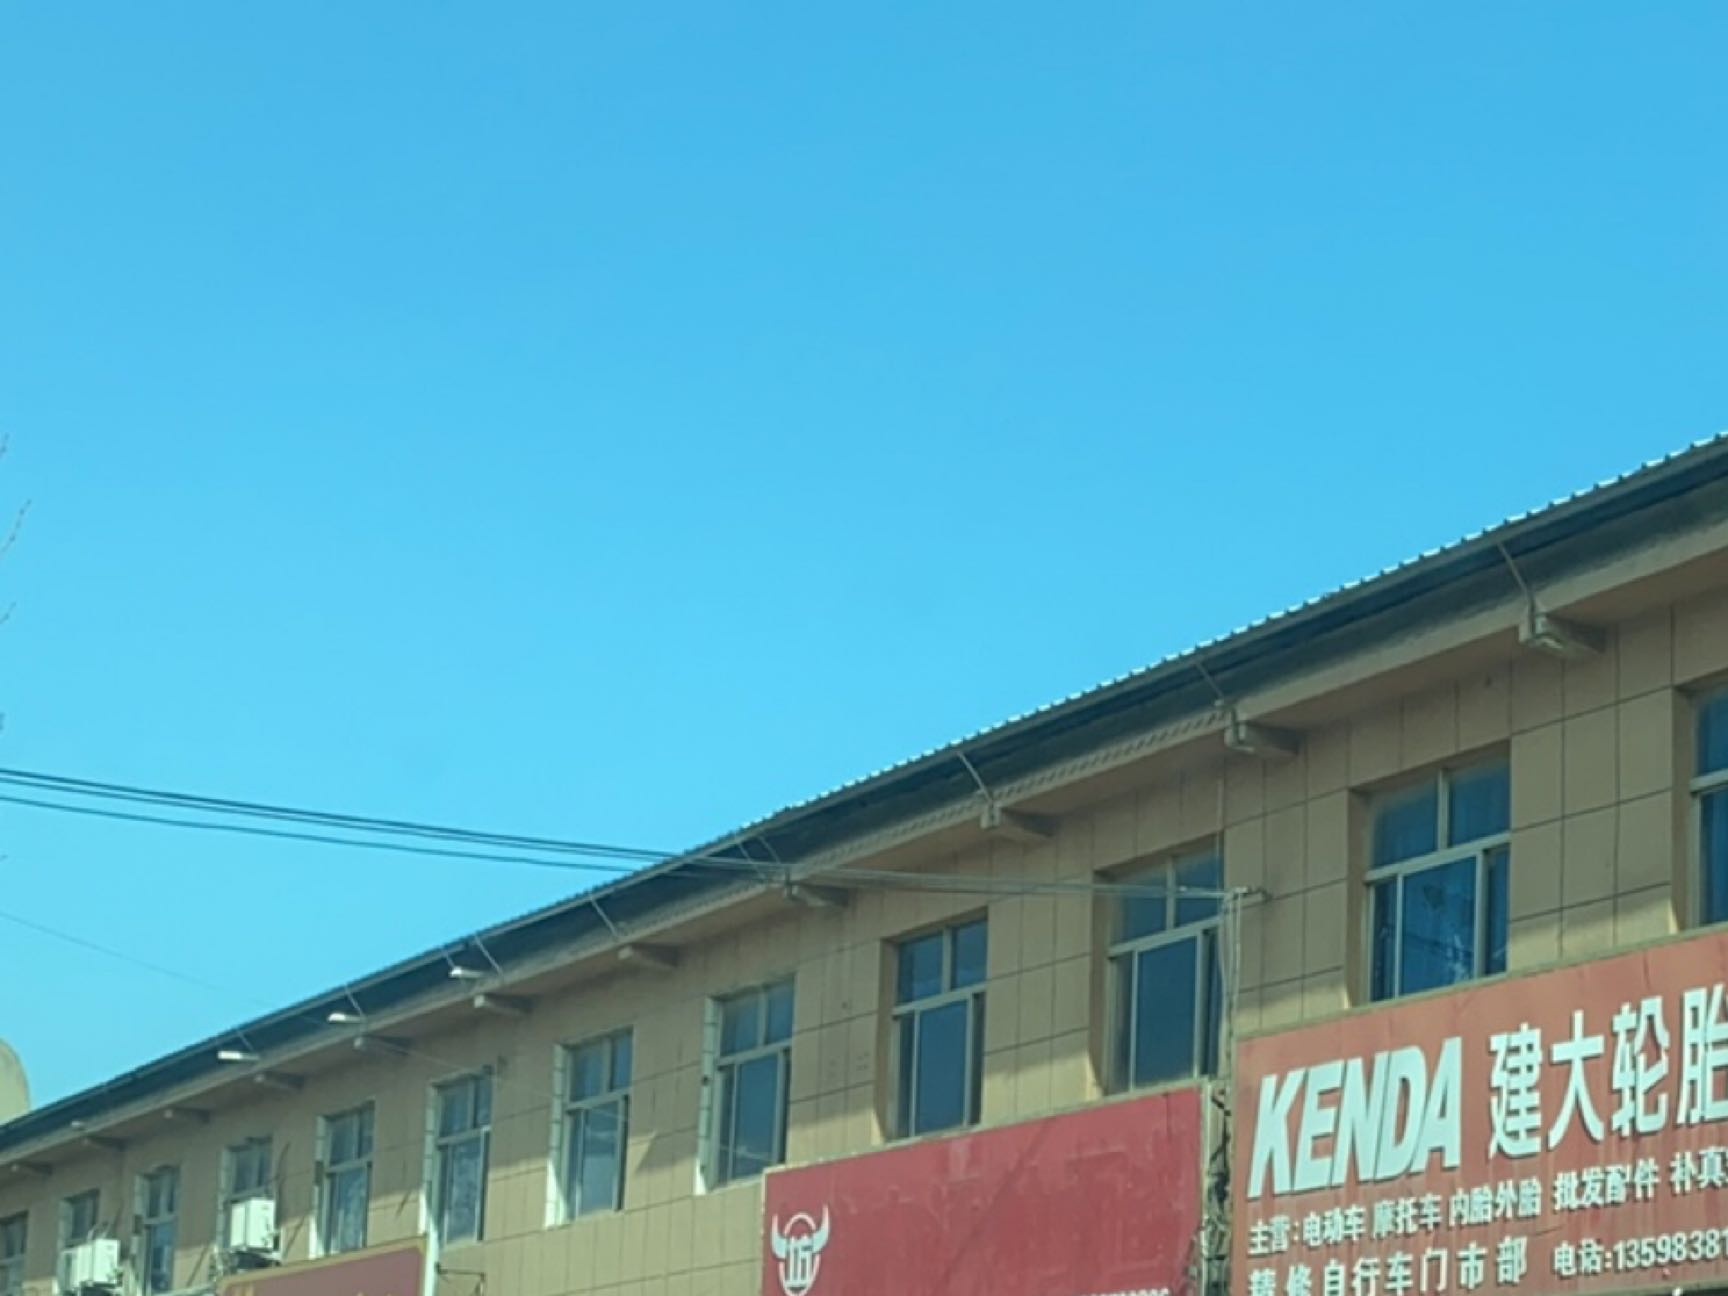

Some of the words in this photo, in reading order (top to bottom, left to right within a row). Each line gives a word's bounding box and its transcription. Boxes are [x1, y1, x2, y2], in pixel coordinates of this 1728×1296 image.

[1248, 1037, 1463, 1198] KENDA
[1373, 1193, 1442, 1238] 摩托车
[1449, 1177, 1542, 1227] 内胎外胎
[1554, 1159, 1659, 1210] 批发配件
